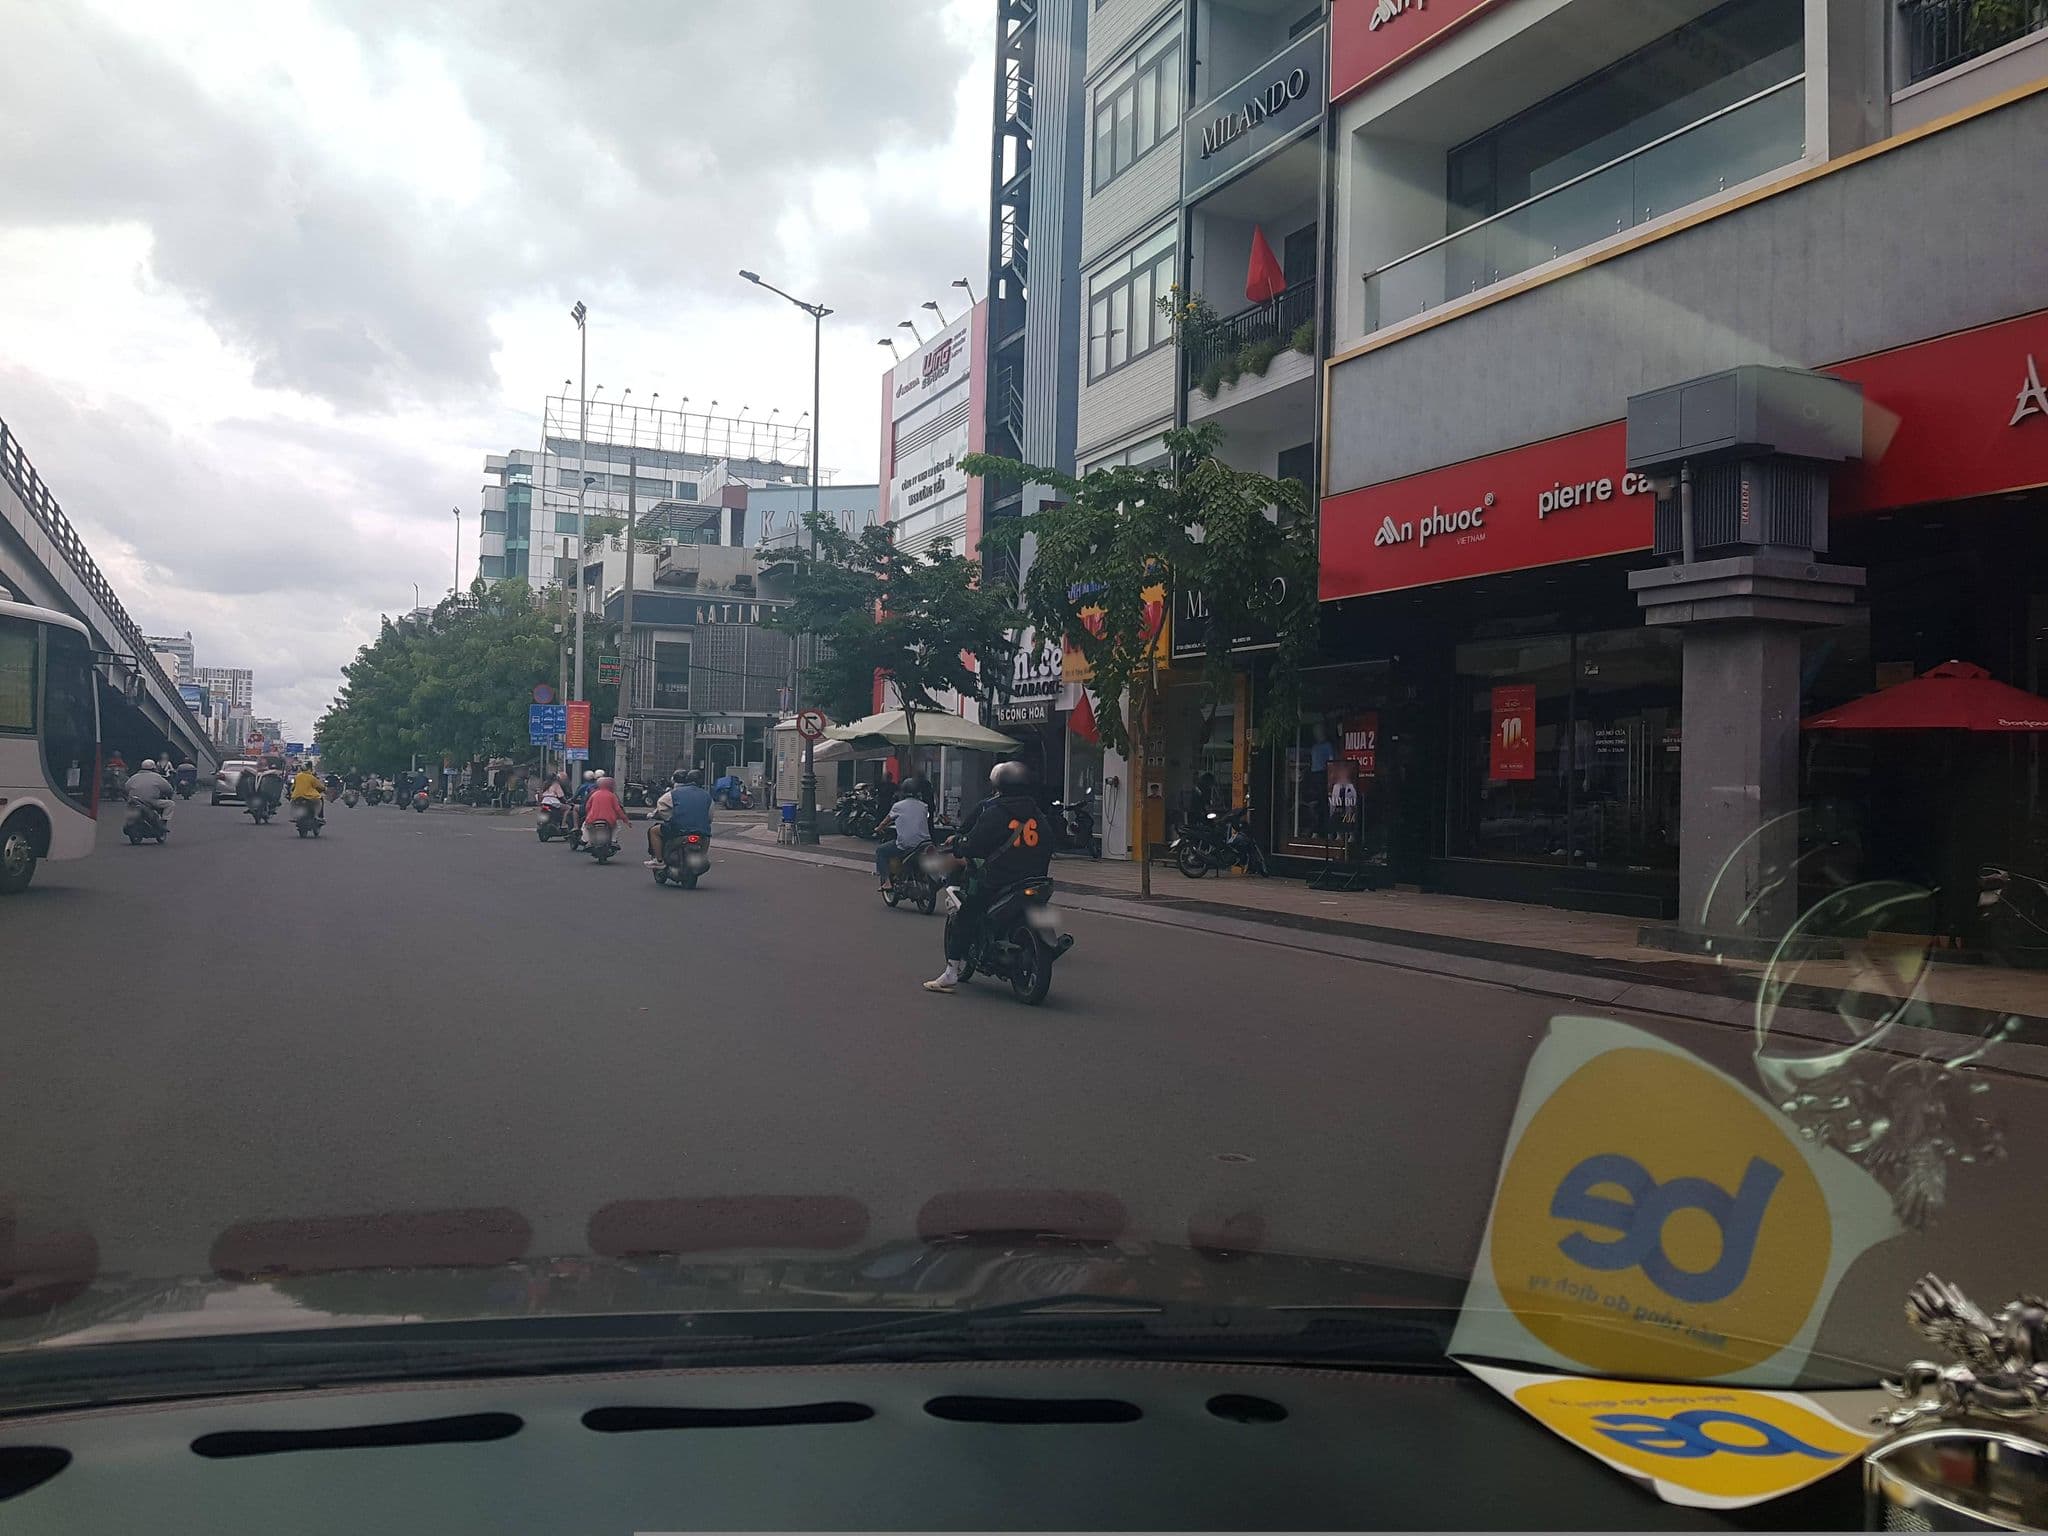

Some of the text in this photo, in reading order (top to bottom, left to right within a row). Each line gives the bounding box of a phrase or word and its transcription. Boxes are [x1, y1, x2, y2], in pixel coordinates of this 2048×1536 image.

[1200, 67, 1308, 160] MILANDO
[1538, 478, 1612, 519] pierre
[1374, 505, 1482, 548] An phuoc
[1456, 533, 1486, 544] VIETNAM
[1013, 648, 1063, 680] nce
[1344, 731, 1375, 750] MUA 2
[1590, 1410, 1848, 1459] be
